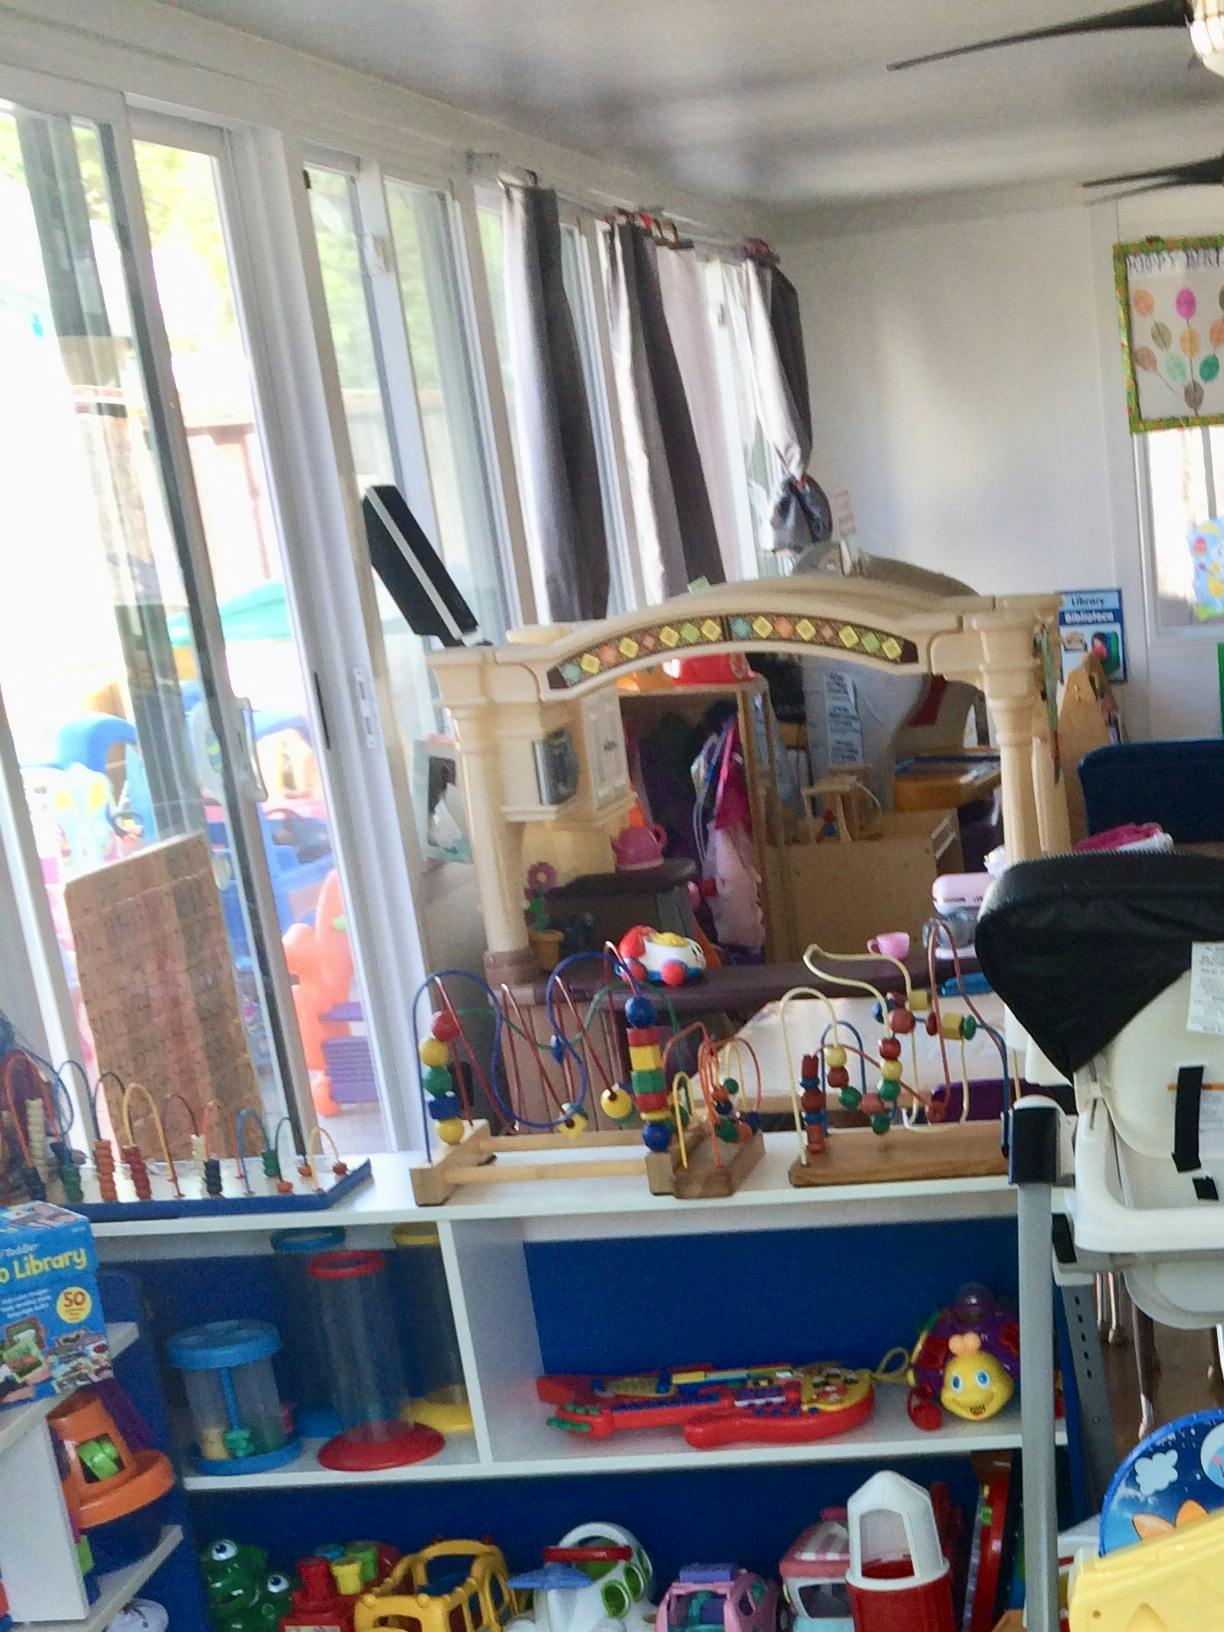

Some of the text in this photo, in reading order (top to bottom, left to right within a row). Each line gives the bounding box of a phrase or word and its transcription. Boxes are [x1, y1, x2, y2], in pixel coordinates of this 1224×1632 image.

[1071, 596, 1105, 608] Library
[1064, 610, 1114, 624] Biblioteca
[13, 1248, 87, 1279] Library
[64, 1291, 85, 1307] 50
